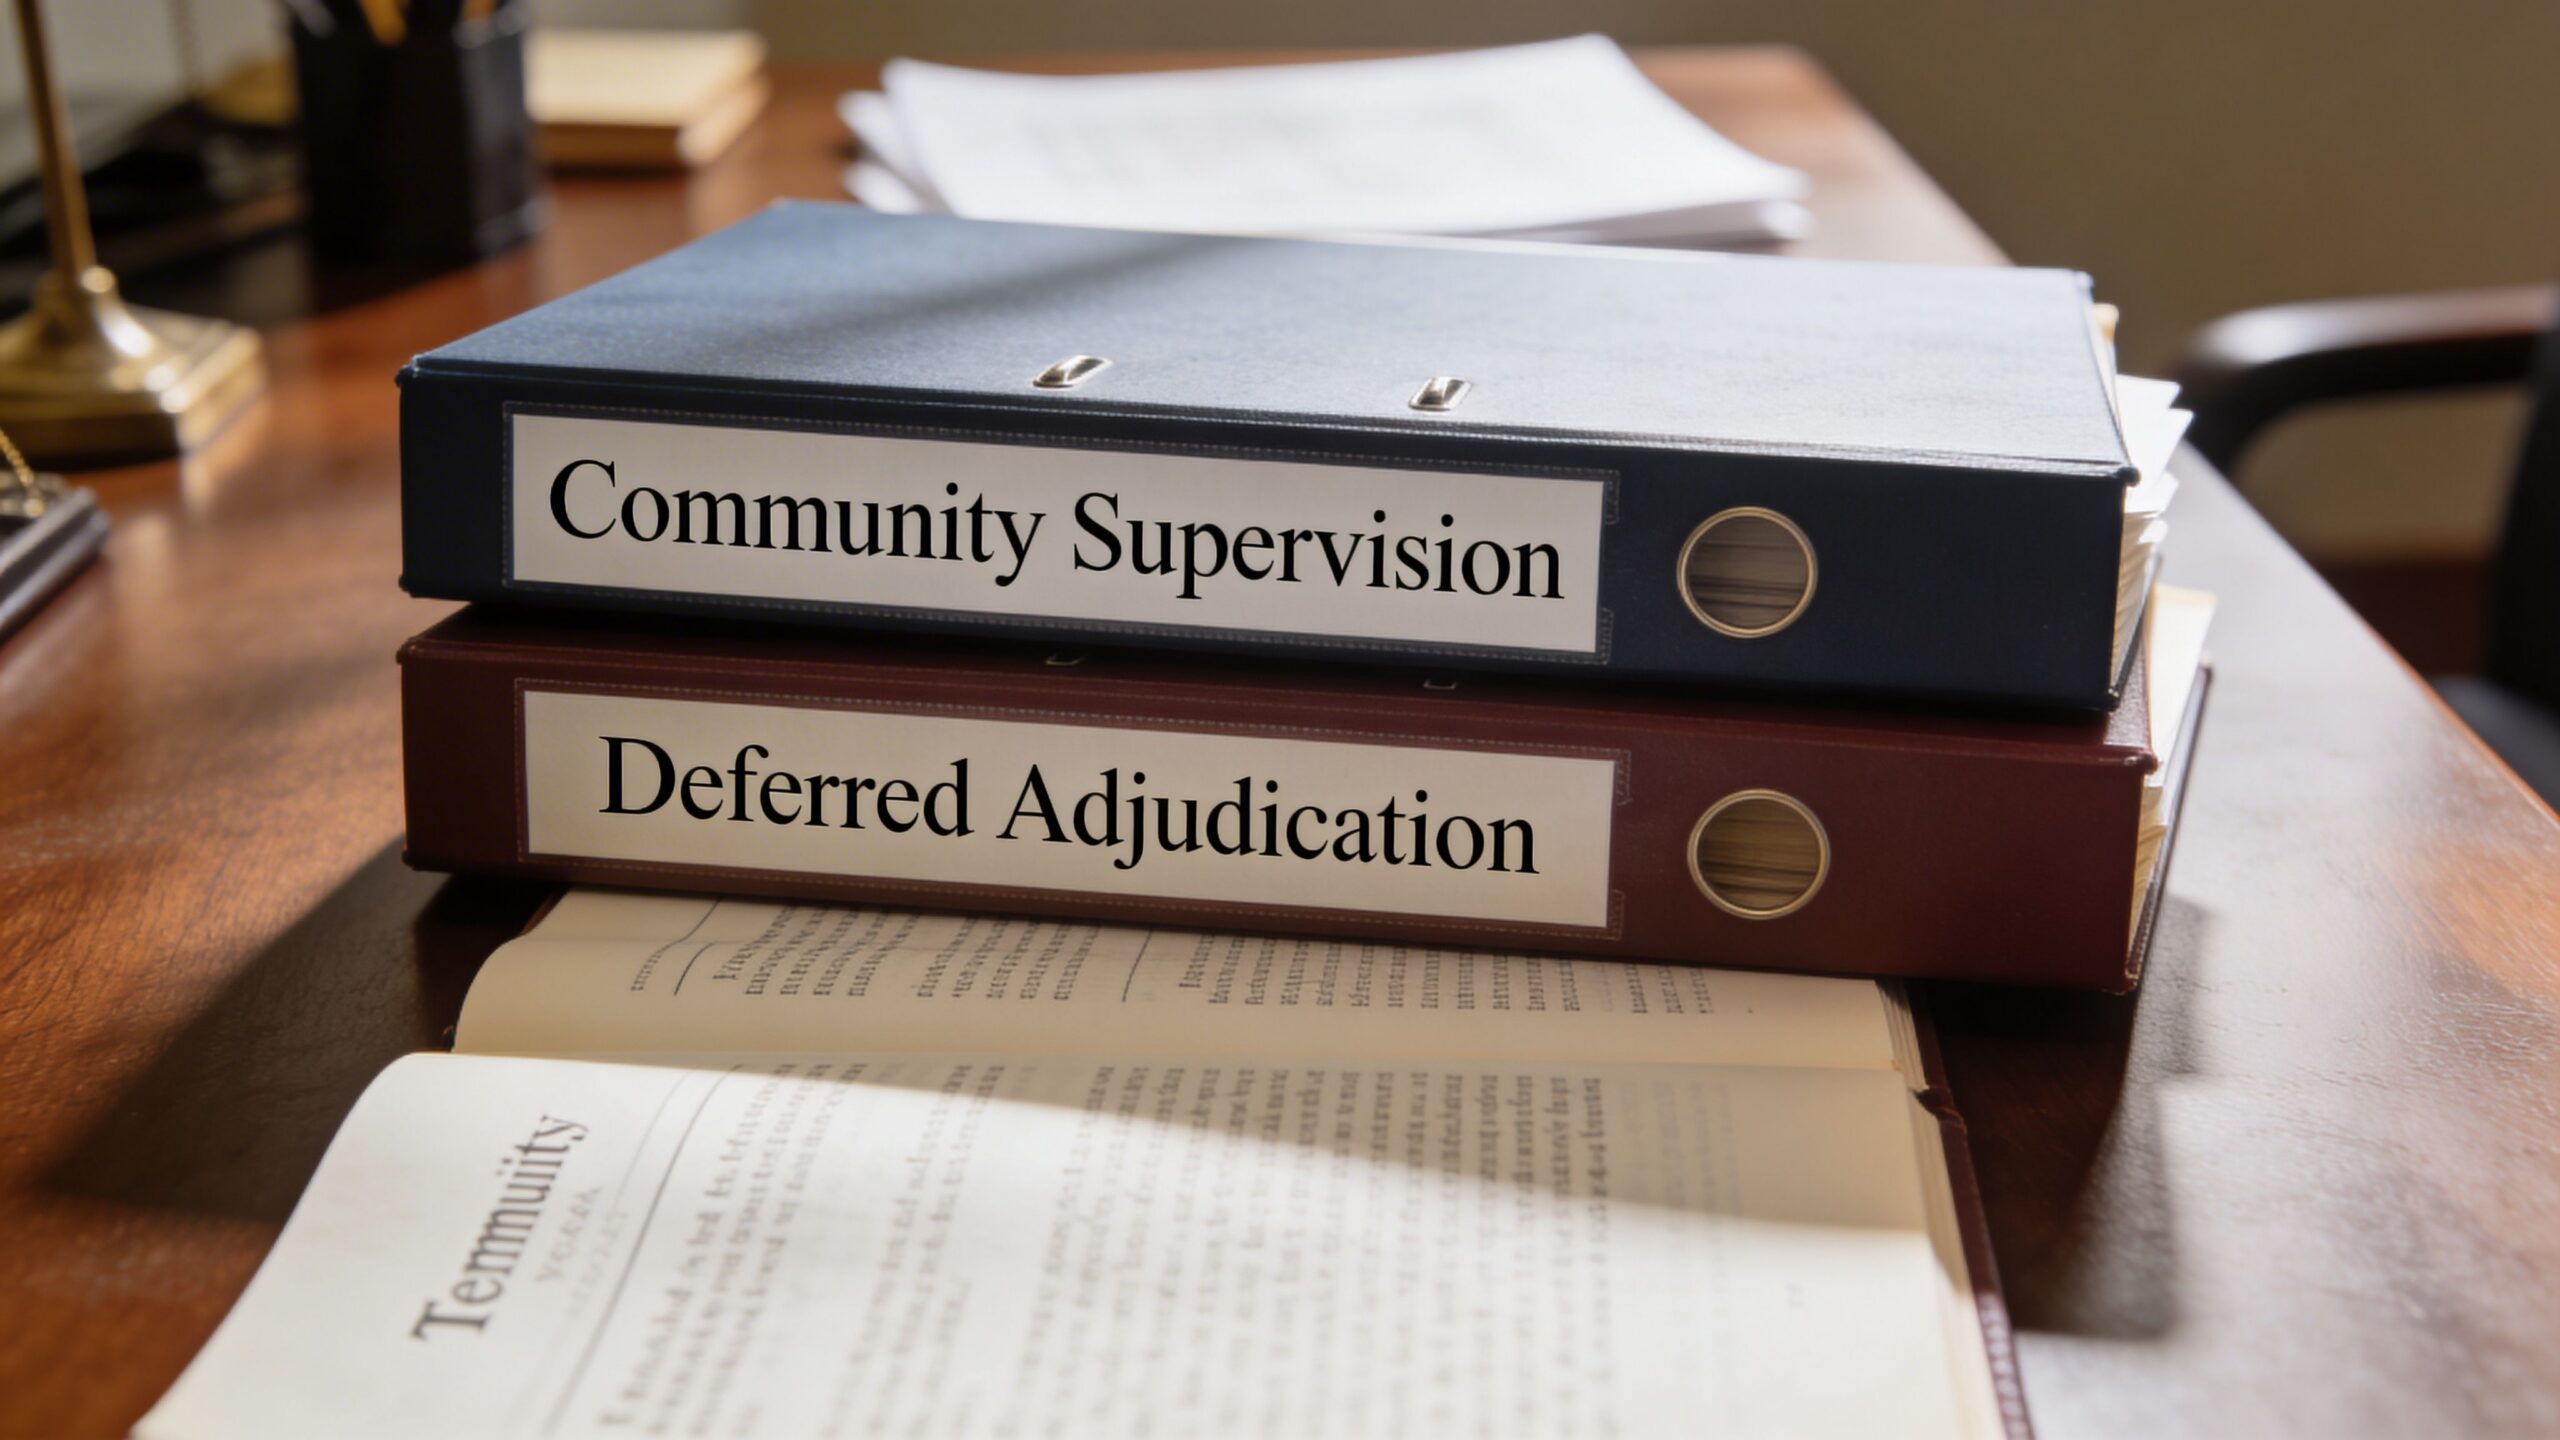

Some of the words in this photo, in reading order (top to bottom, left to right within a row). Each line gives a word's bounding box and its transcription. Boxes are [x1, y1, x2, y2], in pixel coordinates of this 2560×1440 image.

[549, 459, 1047, 589] Community
[1073, 491, 1565, 601] Supervision
[598, 735, 976, 839] Deferred
[996, 763, 1541, 876] Adjudication
